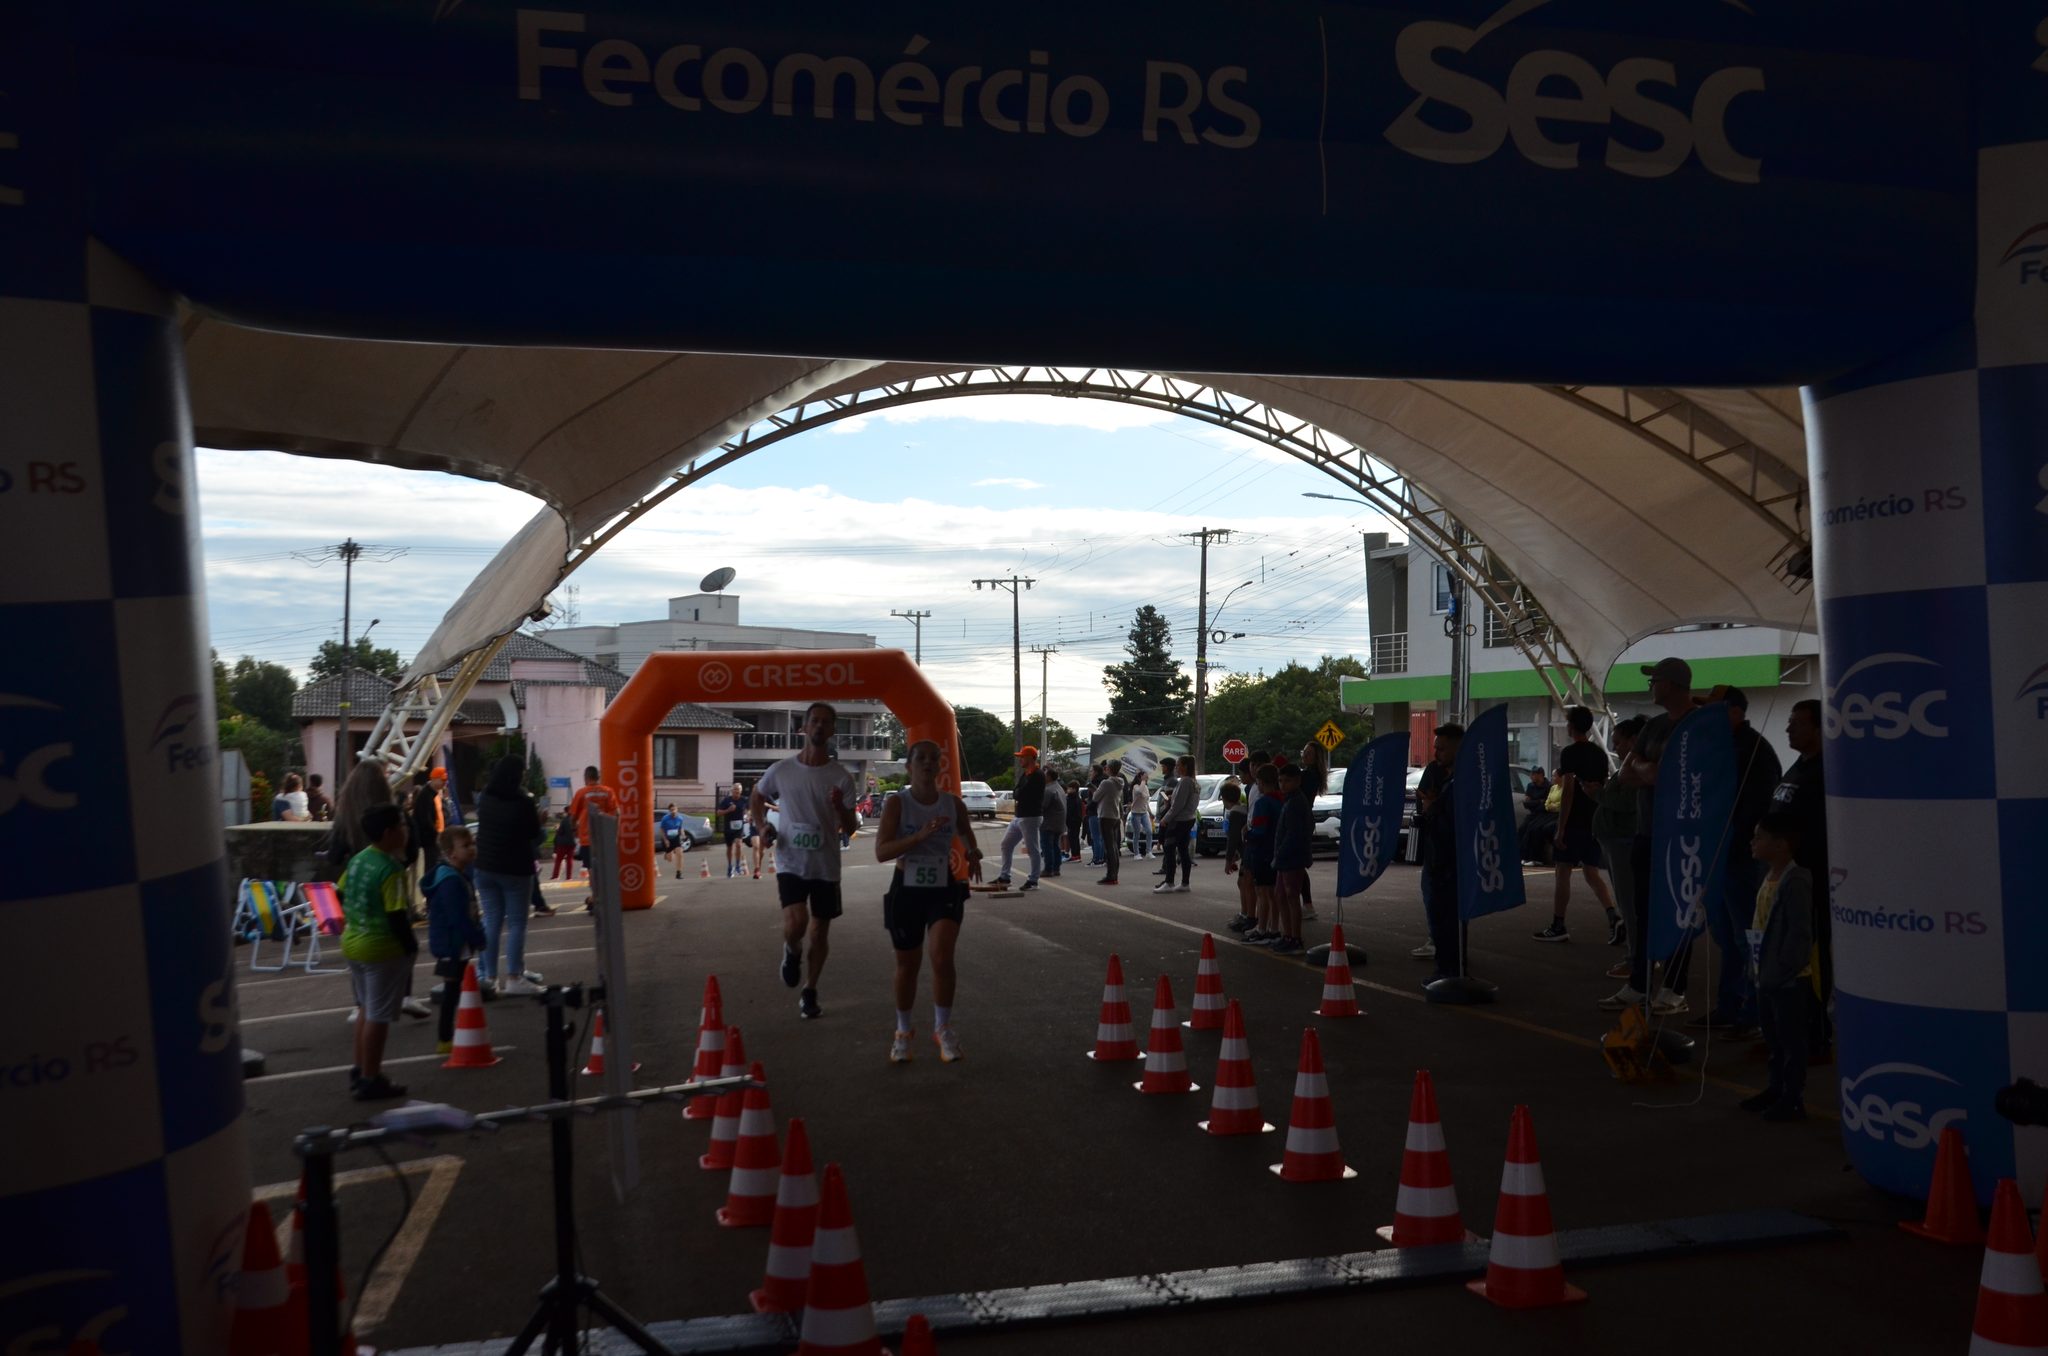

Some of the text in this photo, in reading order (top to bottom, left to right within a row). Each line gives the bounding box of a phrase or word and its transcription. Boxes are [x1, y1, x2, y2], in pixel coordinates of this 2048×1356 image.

[515, 9, 1262, 149] Fecomércio RS
[1382, 20, 1766, 185] Sesc
[28, 462, 86, 494] RS
[1923, 486, 1967, 513] RS
[742, 662, 864, 688] CRESOL
[1224, 747, 1245, 756] PARE
[1678, 730, 1689, 820] Fecomércio
[1363, 748, 1376, 806] Fecomércio
[618, 751, 641, 855] CRESOL
[793, 832, 820, 848] 400
[1359, 815, 1382, 878] Sesc
[1478, 819, 1504, 893] Sesc
[915, 866, 938, 884] 55
[1675, 835, 1703, 930] Sesc
[1832, 902, 1987, 935] ecomércio RS
[84, 1035, 139, 1072] RS
